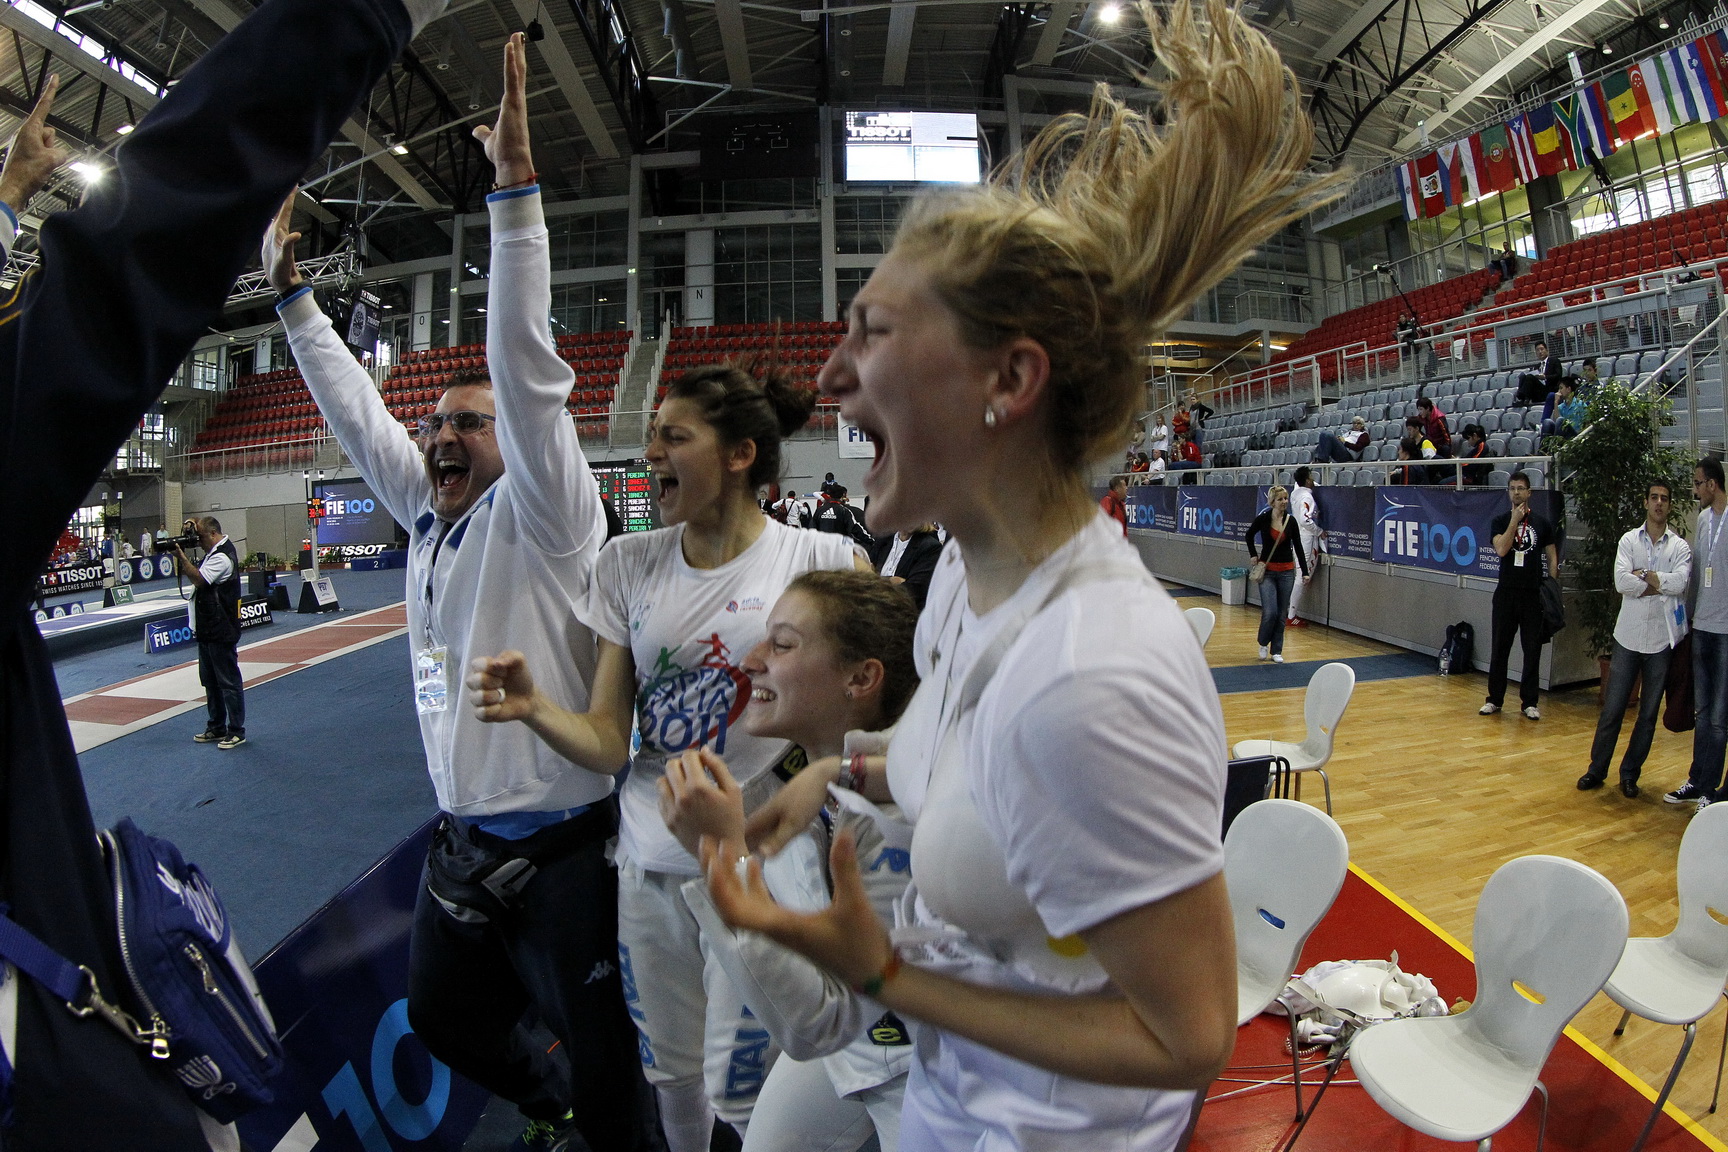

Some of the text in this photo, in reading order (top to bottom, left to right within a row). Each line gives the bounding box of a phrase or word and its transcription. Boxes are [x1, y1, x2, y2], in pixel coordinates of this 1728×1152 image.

[847, 127, 911, 137] TISSOT
[696, 289, 703, 299] N
[262, 341, 266, 350] P
[325, 498, 375, 515] FIE100
[1183, 507, 1224, 533] FIE100
[1384, 519, 1477, 566] FIE100
[373, 560, 379, 568] 2
[1479, 554, 1499, 563] FENCING
[57, 566, 102, 584] TISSOT
[57, 583, 80, 592] WATCHES
[80, 580, 94, 589] SINCE
[240, 602, 267, 619] SSOT
[154, 626, 191, 648] FIE100
[638, 711, 729, 754] 2011
[724, 1003, 771, 1100] ITAL
